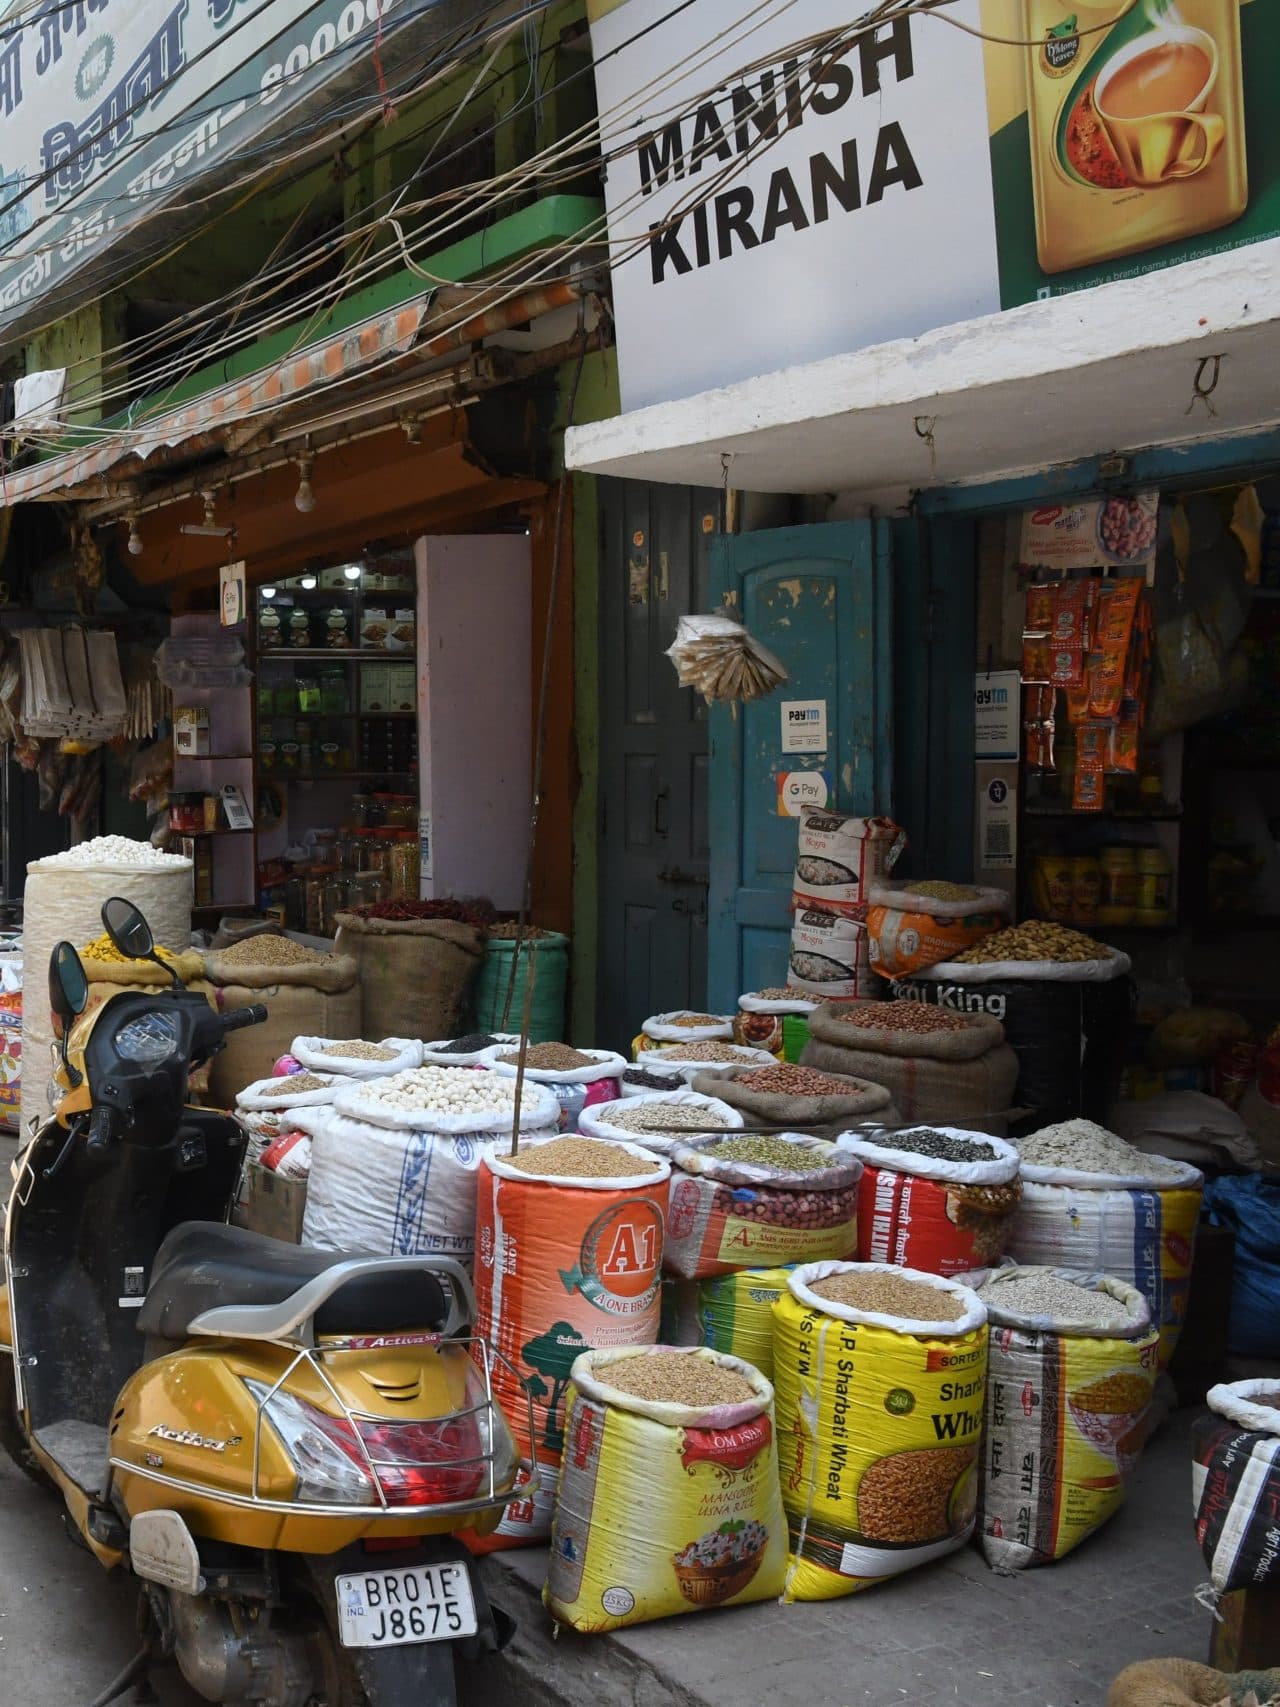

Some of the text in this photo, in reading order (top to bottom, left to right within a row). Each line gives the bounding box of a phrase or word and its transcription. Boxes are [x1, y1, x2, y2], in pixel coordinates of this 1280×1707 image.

[637, 7, 914, 197] MANISH
[649, 121, 924, 285] KIRANA
[1113, 265, 1139, 281] brand
[1141, 259, 1167, 274] name
[1169, 253, 1188, 268] and
[1189, 246, 1213, 261] does
[1215, 241, 1233, 254] not
[801, 783, 819, 798] Pay
[937, 985, 1007, 1021] King
[422, 1235, 448, 1248] NET
[602, 1223, 657, 1276] A1
[595, 1285, 657, 1314] A ONE BRAND
[369, 1335, 424, 1349] Activa
[798, 1342, 812, 1377] M.P.
[833, 1358, 854, 1439] Sharbati
[713, 1436, 737, 1450] OM
[826, 1443, 848, 1501] Wheat
[733, 1498, 755, 1511] RICE
[365, 1568, 455, 1607] BR01E
[347, 1607, 364, 1617] IND
[372, 1602, 462, 1641] J8675
